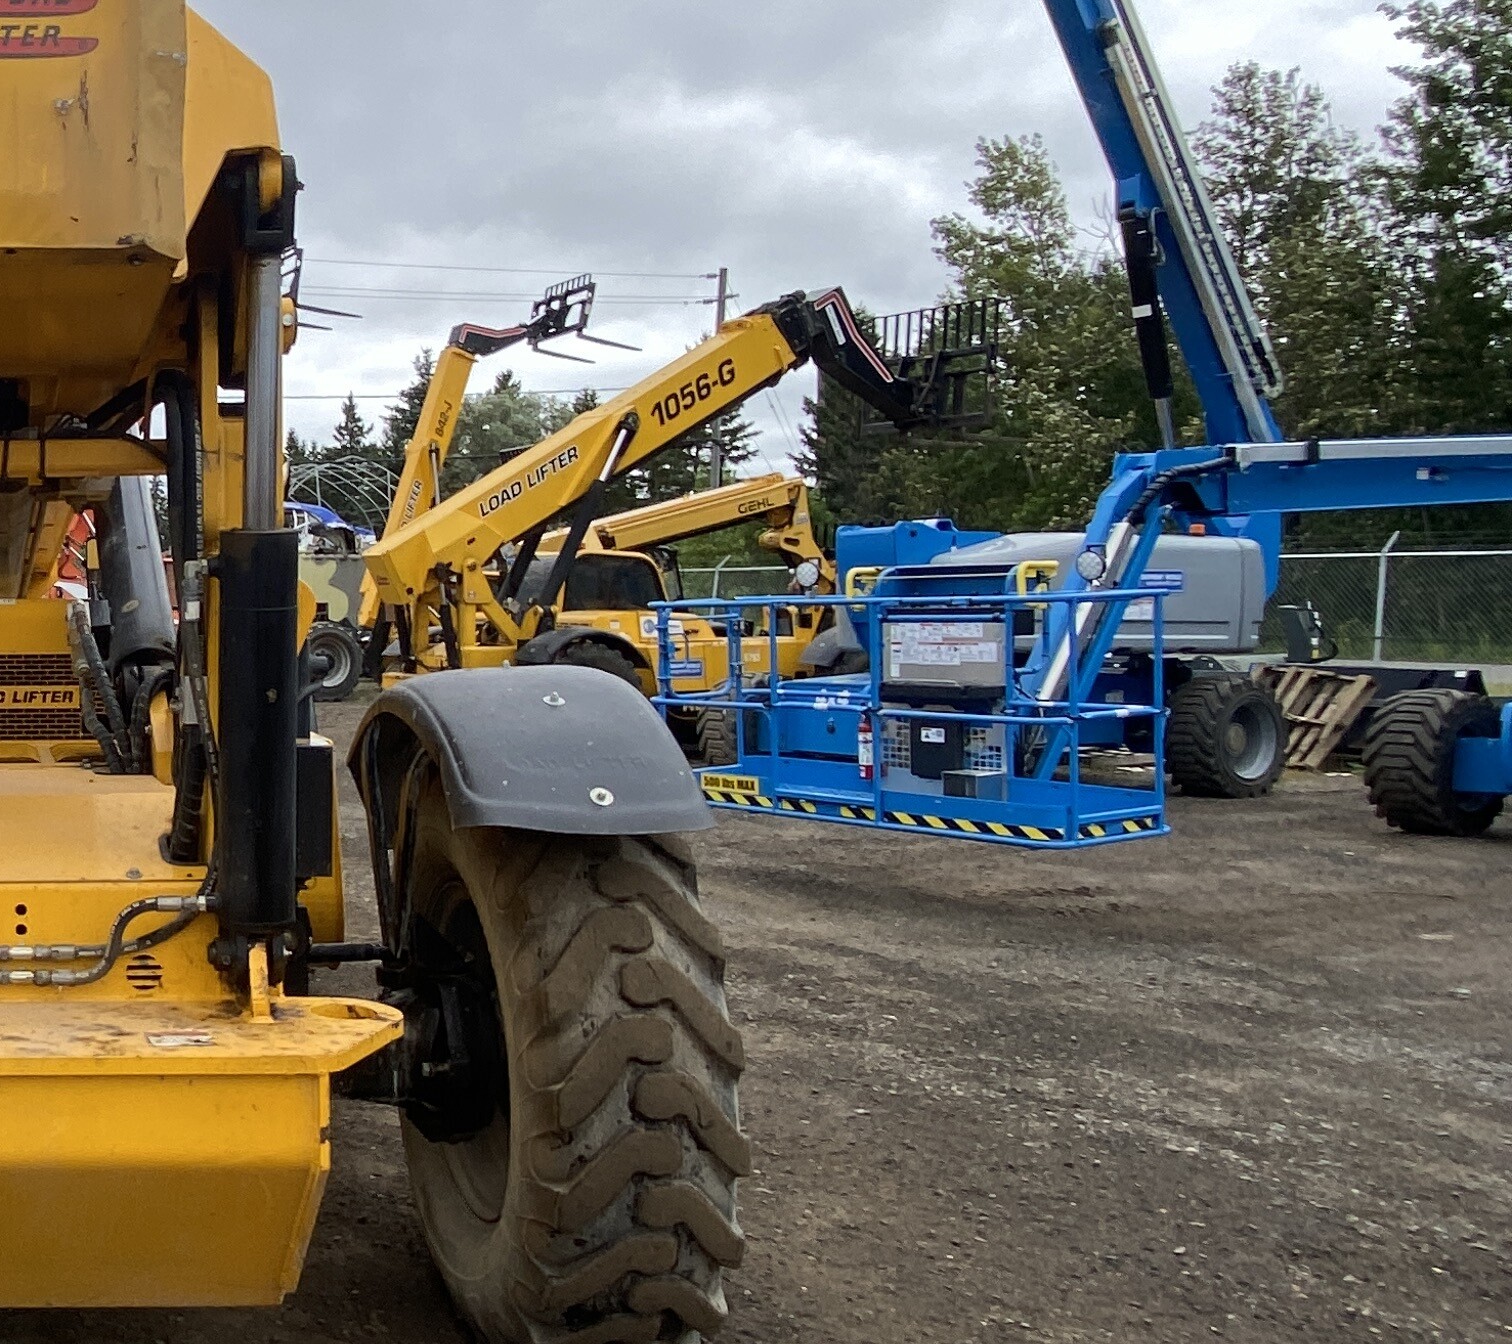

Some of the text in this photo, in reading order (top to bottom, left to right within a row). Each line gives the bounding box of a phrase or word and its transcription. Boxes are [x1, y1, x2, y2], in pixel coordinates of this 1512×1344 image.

[650, 358, 736, 426] 1056-G
[479, 446, 579, 517] LOAD LIFTER
[738, 498, 774, 514] GEHL
[11, 690, 74, 704] LIFTER
